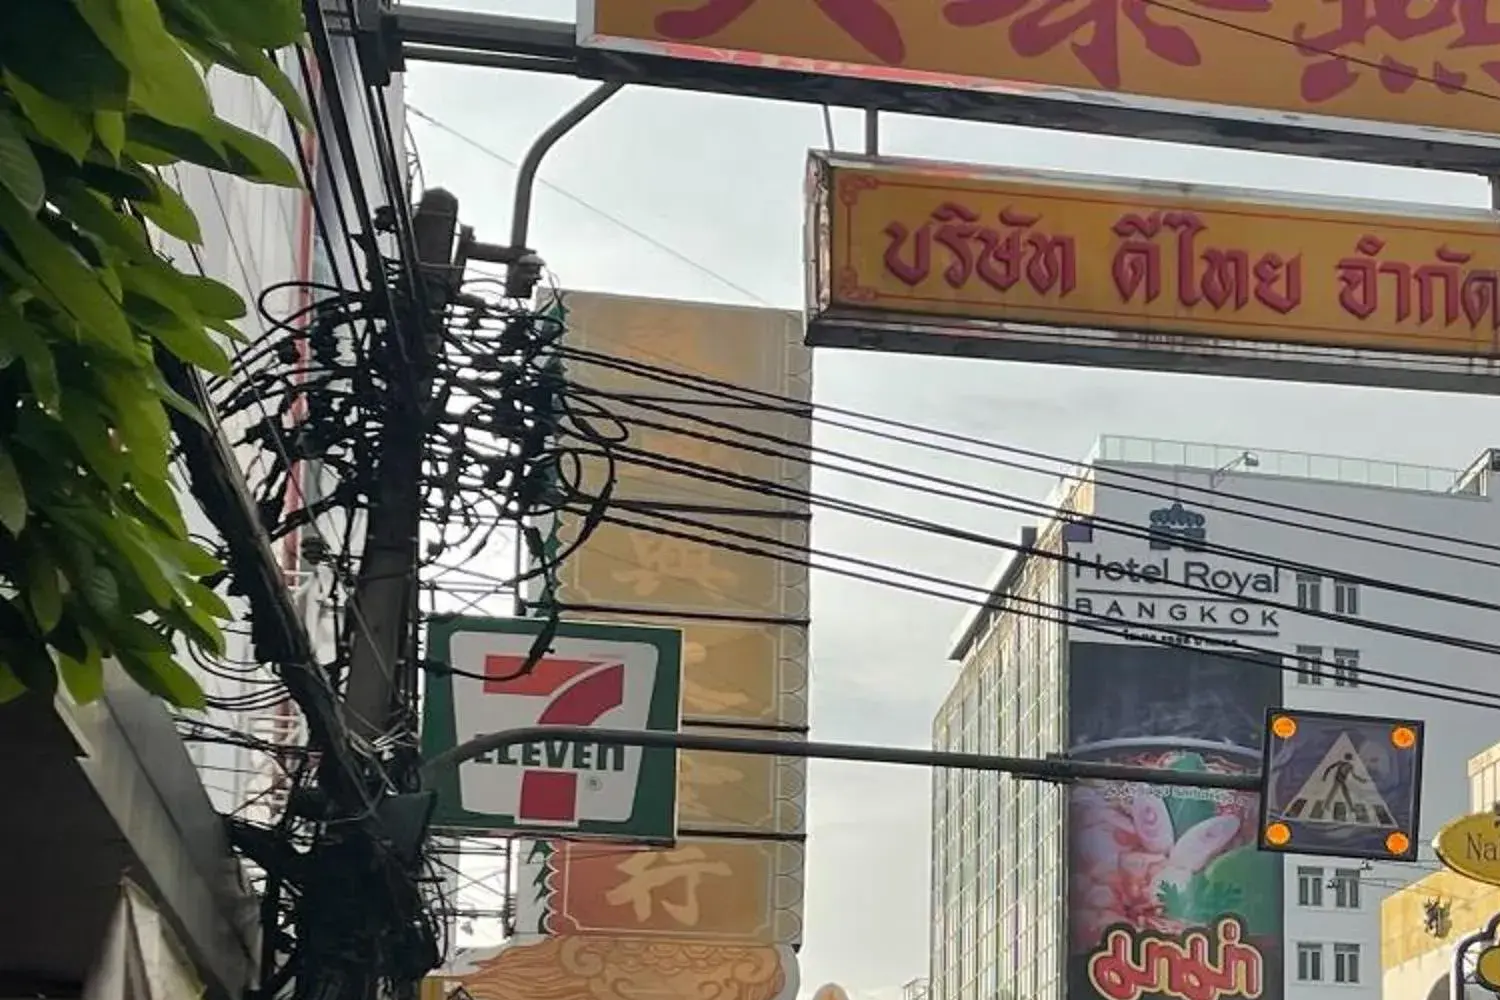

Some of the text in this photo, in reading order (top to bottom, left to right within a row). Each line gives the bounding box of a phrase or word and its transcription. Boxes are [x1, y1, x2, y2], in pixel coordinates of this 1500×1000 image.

[883, 202, 1077, 298] บริษัท
[1075, 552, 1279, 597] Hotel Royal
[1076, 598, 1279, 628] BANGKOK
